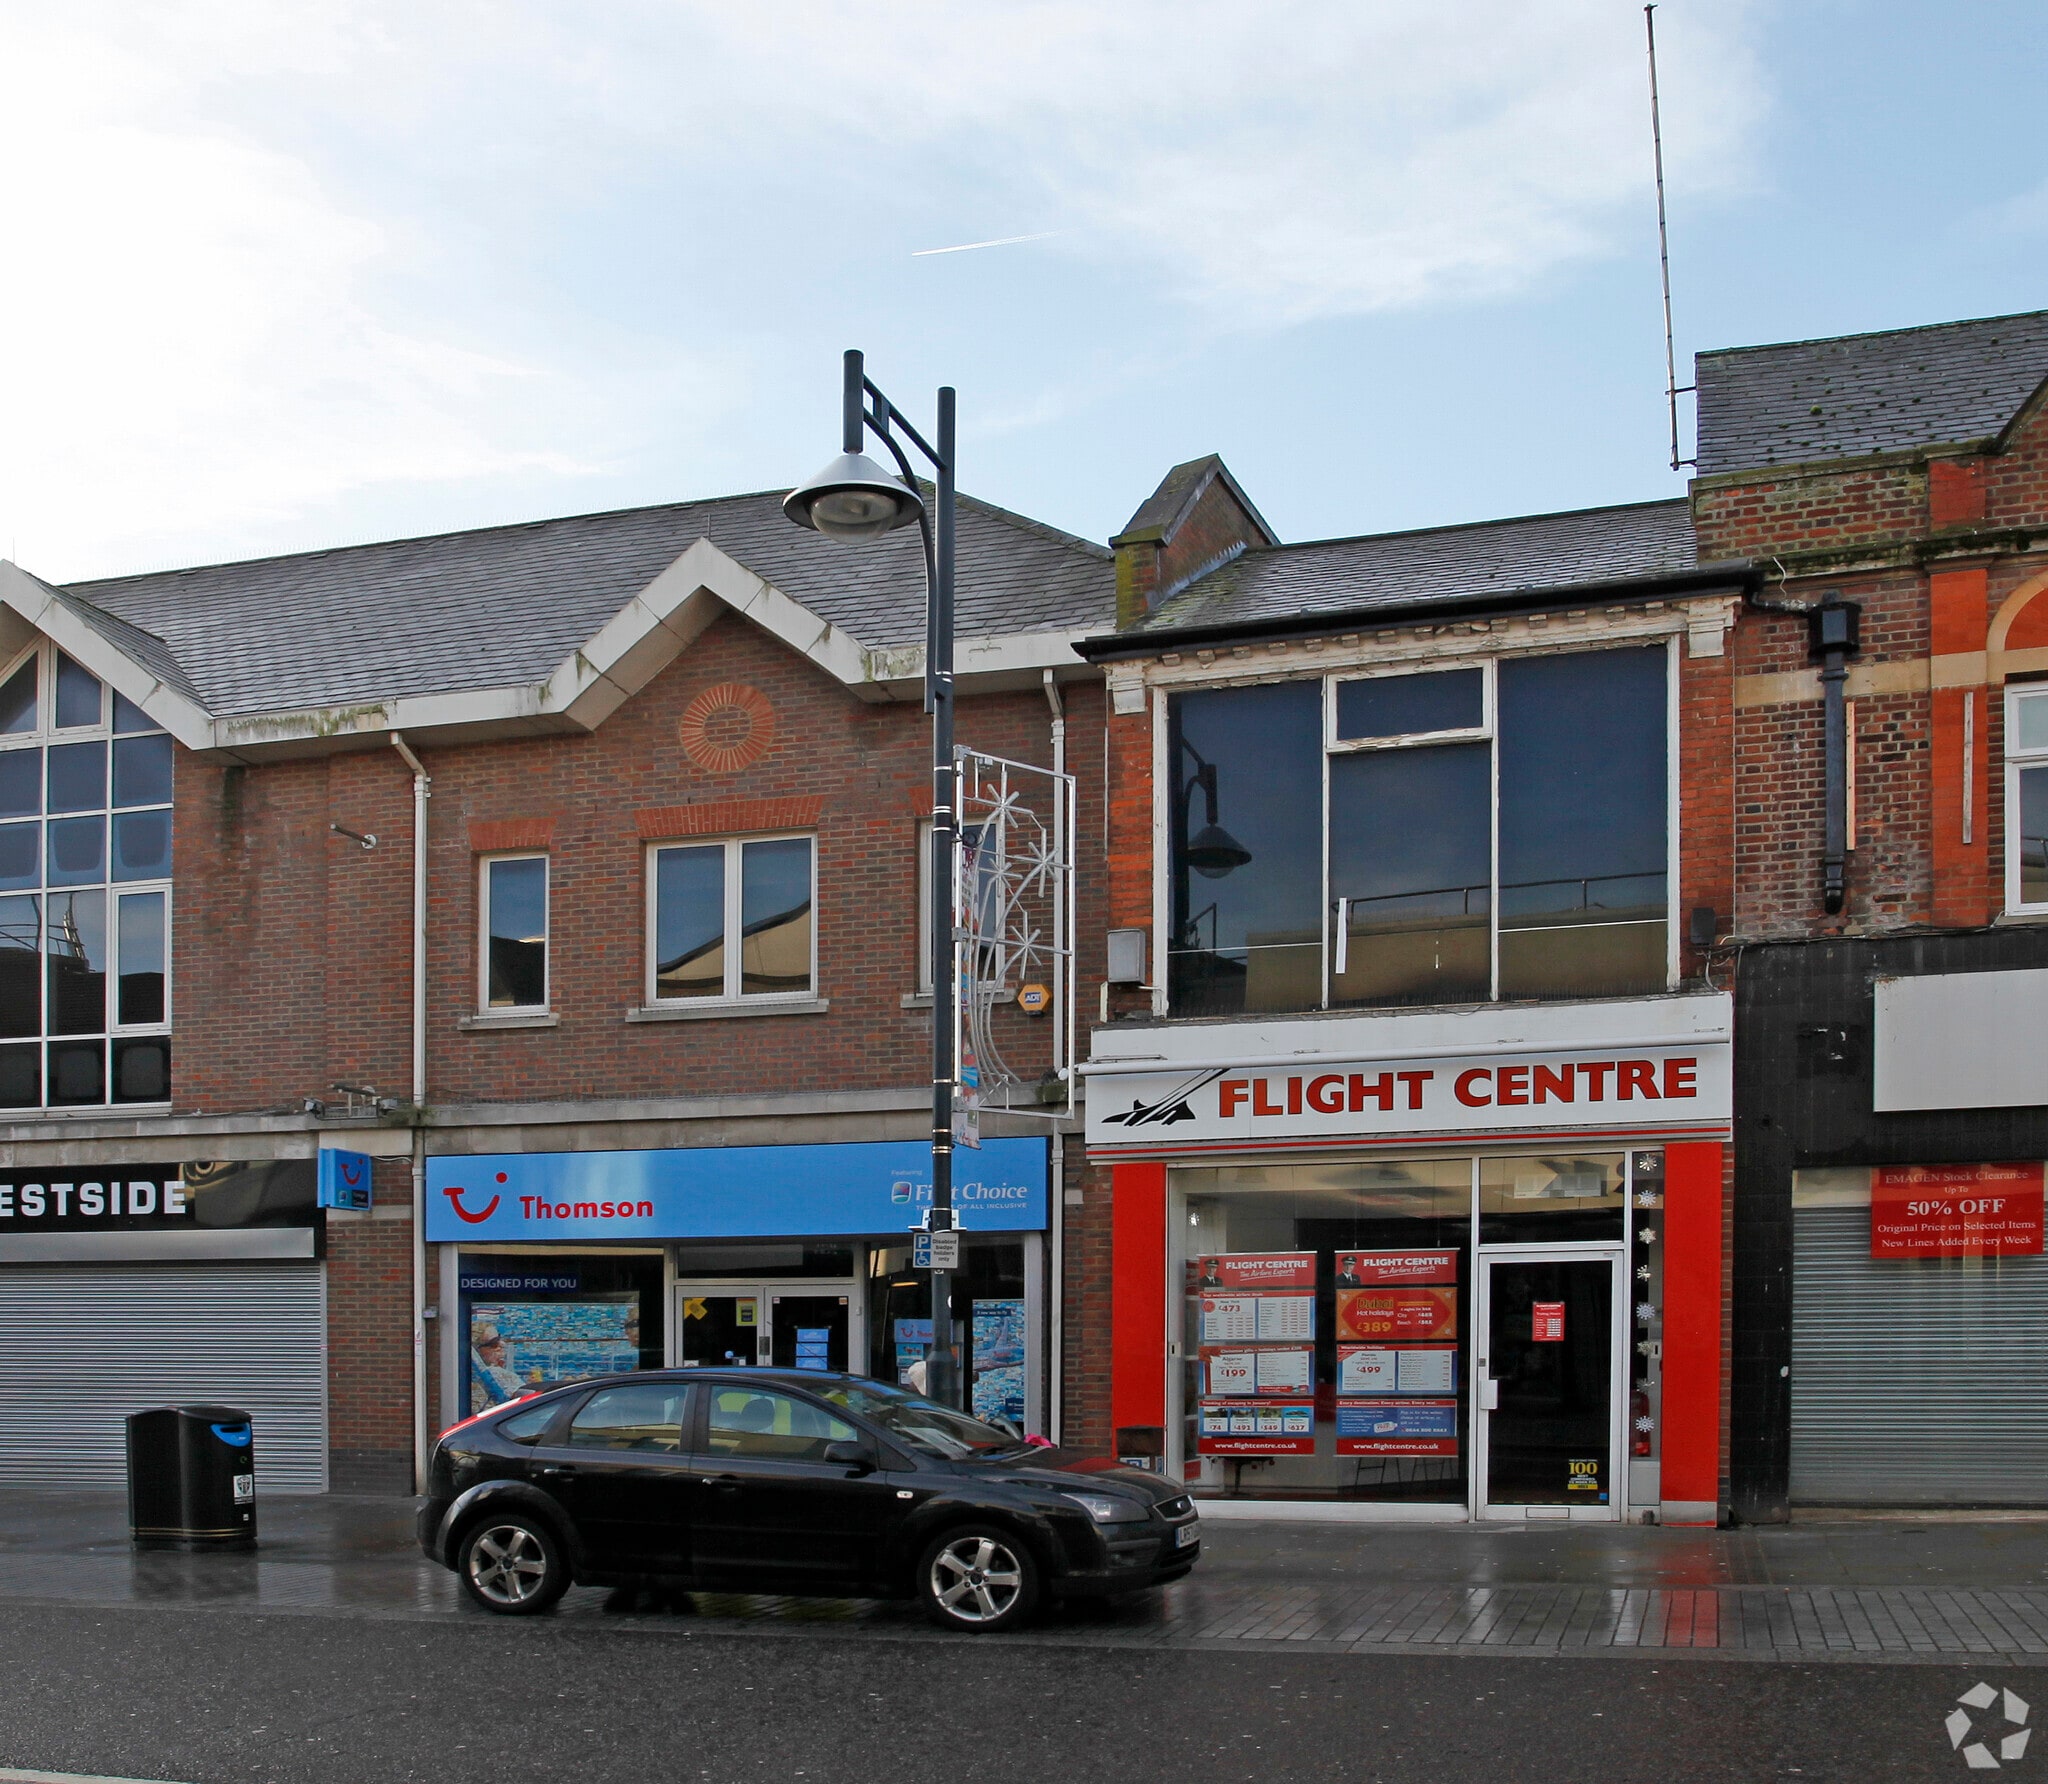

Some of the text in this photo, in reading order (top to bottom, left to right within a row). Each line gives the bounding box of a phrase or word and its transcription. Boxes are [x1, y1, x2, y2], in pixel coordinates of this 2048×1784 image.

[1219, 1057, 1698, 1118] FLIGHT CENTRE
[1943, 1172, 1972, 1182] Stock
[1975, 1170, 2029, 1181] Clearance
[916, 1182, 1028, 1201] Fit Choice
[519, 1196, 653, 1219] Thomson
[1907, 1198, 2006, 1216] 50% OFF
[1877, 1223, 1918, 1234] Original
[1921, 1222, 1946, 1232] Price
[1964, 1221, 2005, 1231] Selected
[2008, 1220, 2036, 1229] Items
[918, 1236, 928, 1249] P
[1882, 1235, 2032, 1248] New Lines Added Every Week
[1225, 1260, 1308, 1270] FLIGHT CENTRE
[1363, 1257, 1449, 1267] FLIGHT CENTRE
[461, 1278, 577, 1289] DESIGNED FOR YOU
[1215, 1442, 1297, 1451] www.flightcentre.co.uk
[1353, 1443, 1439, 1451] www.flightcentre.co.uk
[1568, 1461, 1598, 1475] 100
